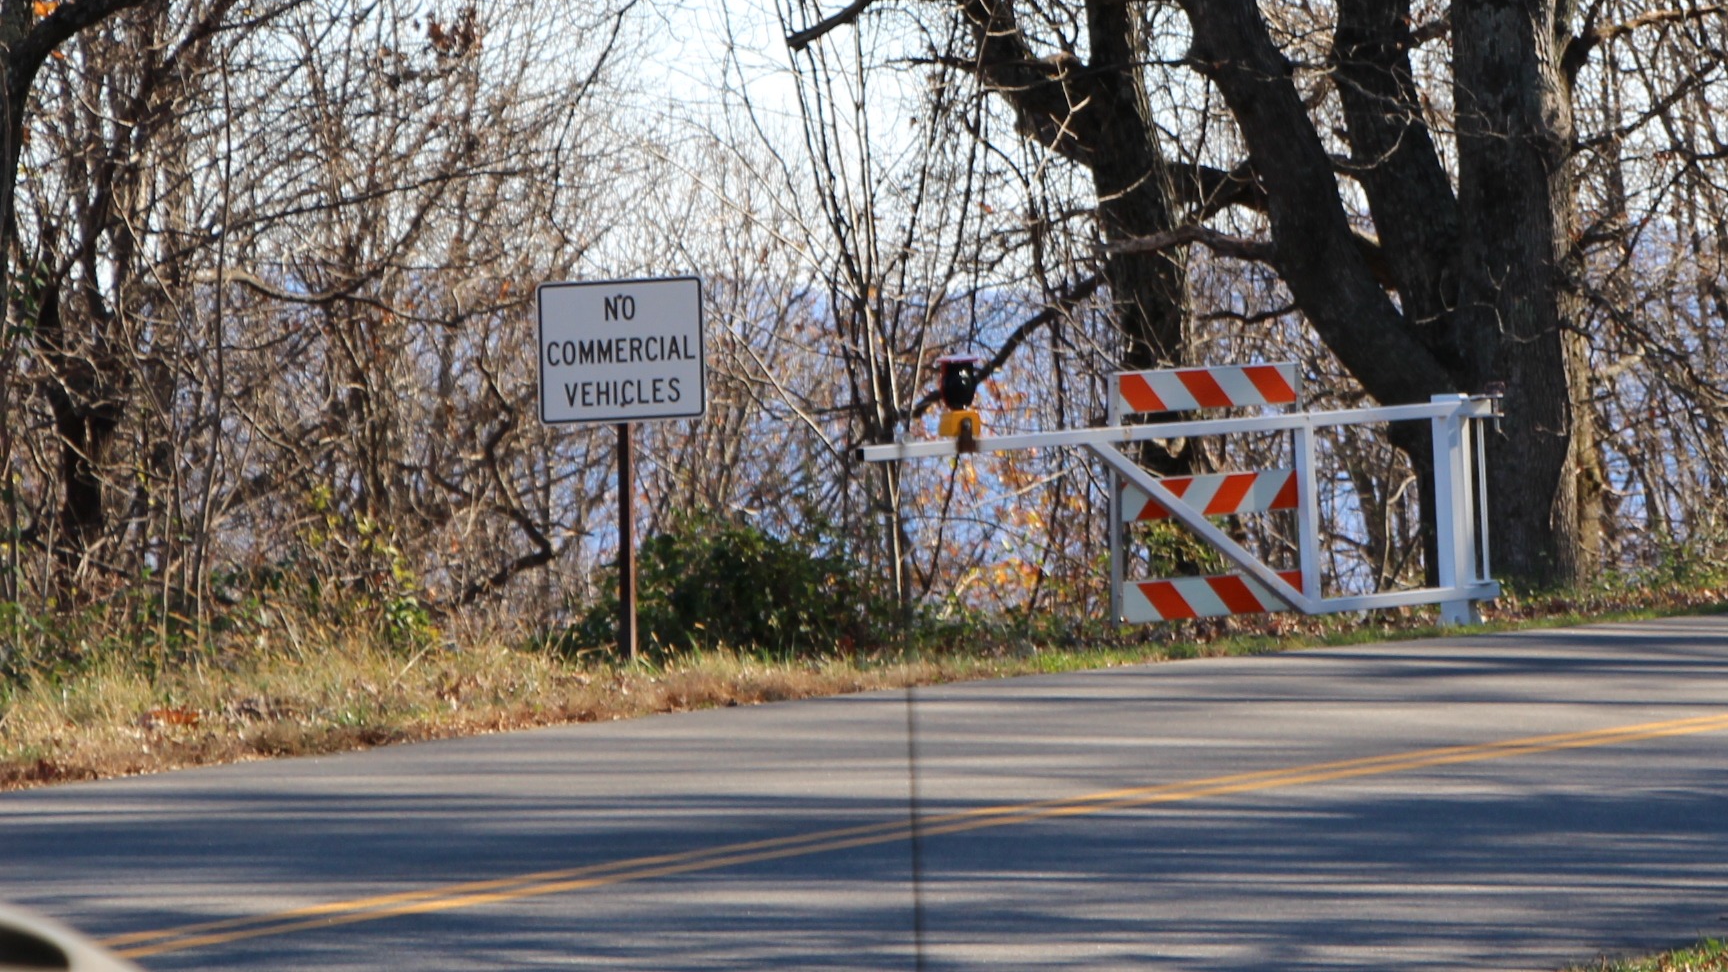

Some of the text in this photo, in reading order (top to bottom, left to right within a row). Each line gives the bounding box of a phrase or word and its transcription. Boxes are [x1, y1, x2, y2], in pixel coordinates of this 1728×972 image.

[604, 295, 635, 321] NO
[546, 334, 695, 366] COMMERCIAL
[564, 378, 681, 407] VEHICLES
